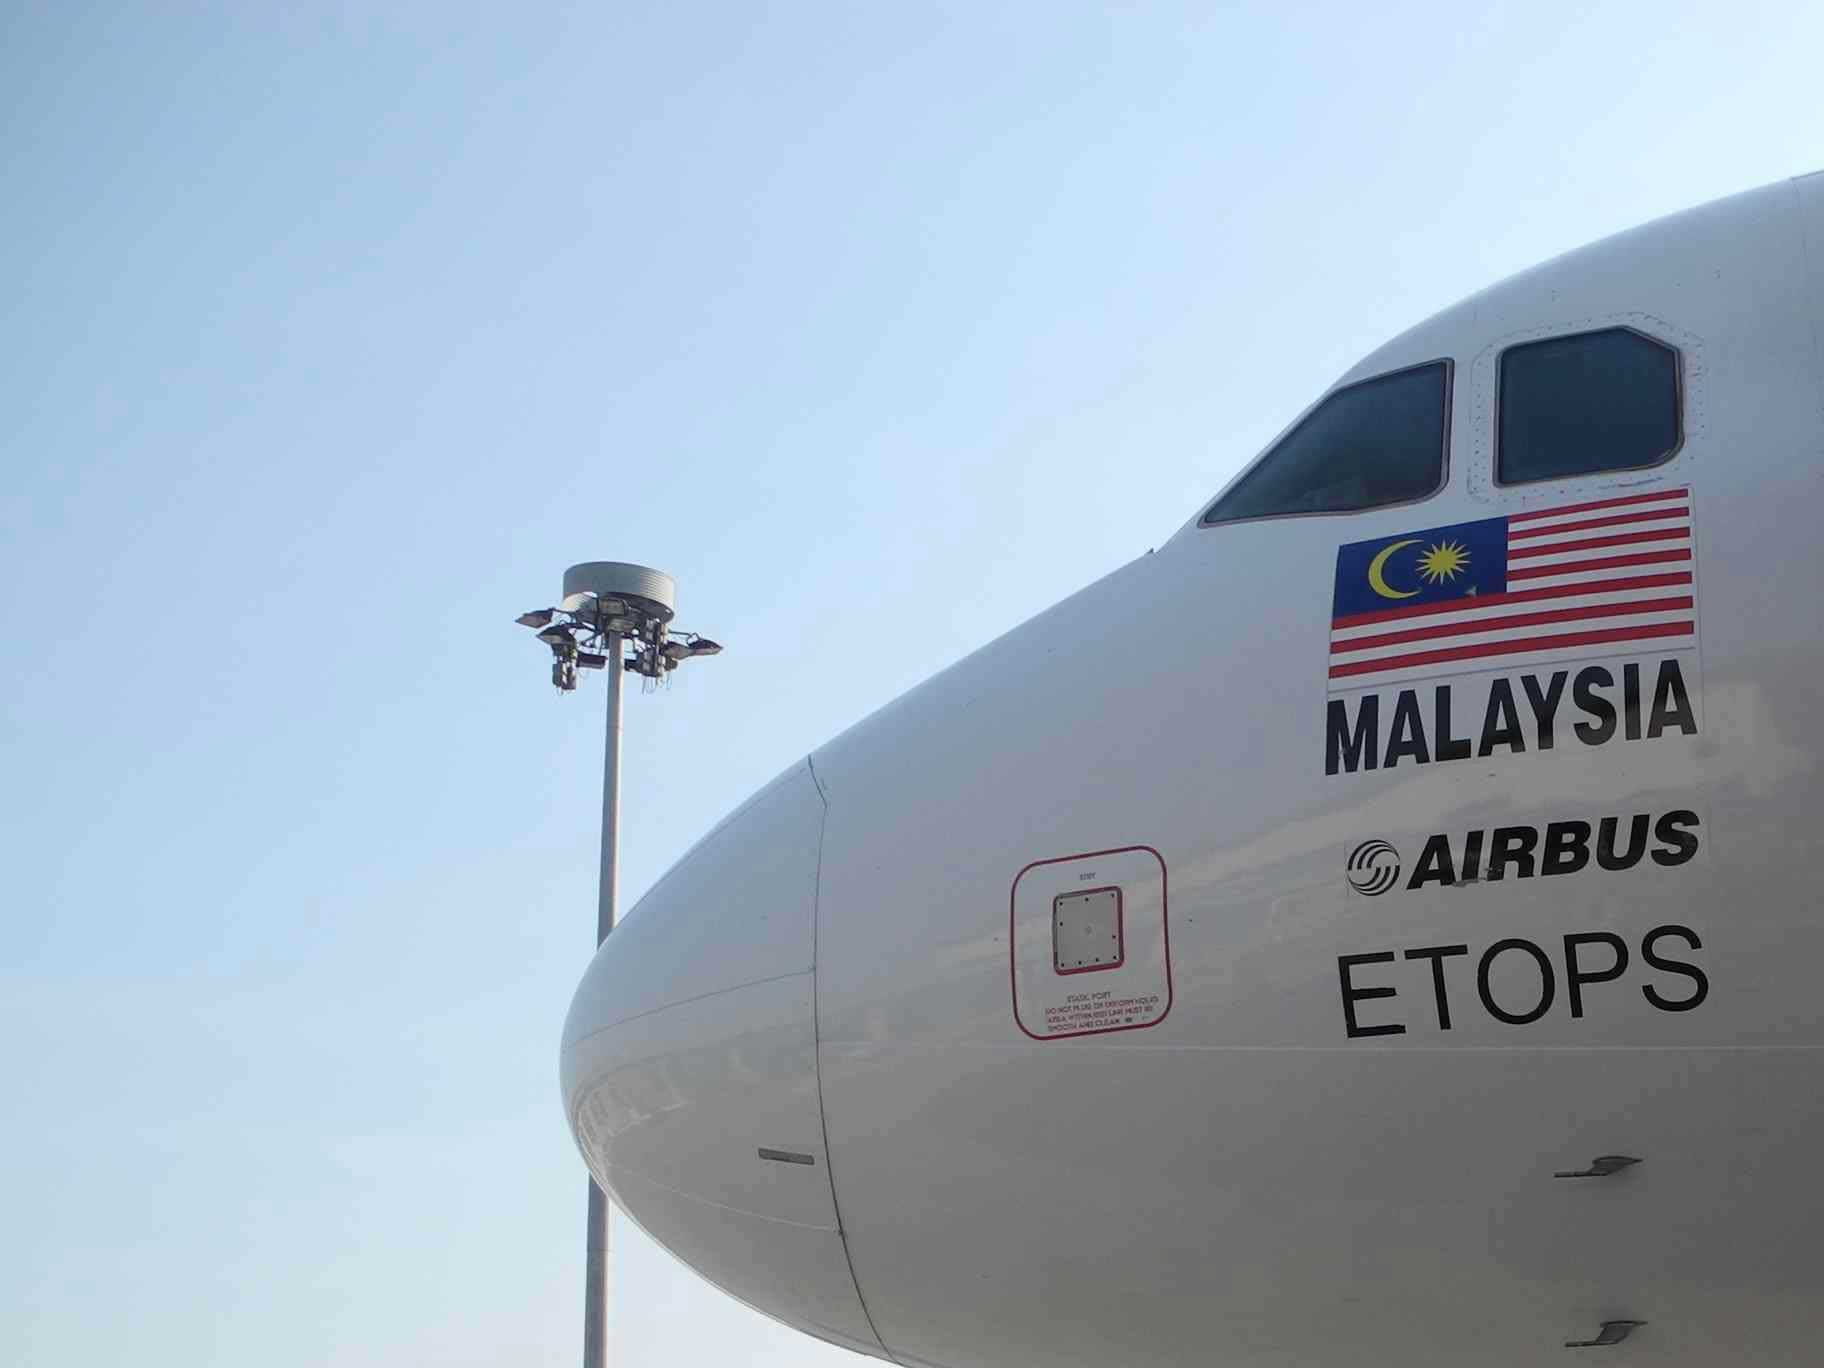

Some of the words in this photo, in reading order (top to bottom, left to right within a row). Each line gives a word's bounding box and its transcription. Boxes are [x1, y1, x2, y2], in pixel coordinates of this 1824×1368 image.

[1325, 658, 1698, 776] MALAYSIA
[1406, 809, 1702, 890] AIRBUS
[1337, 924, 1710, 1039] ETOPS
